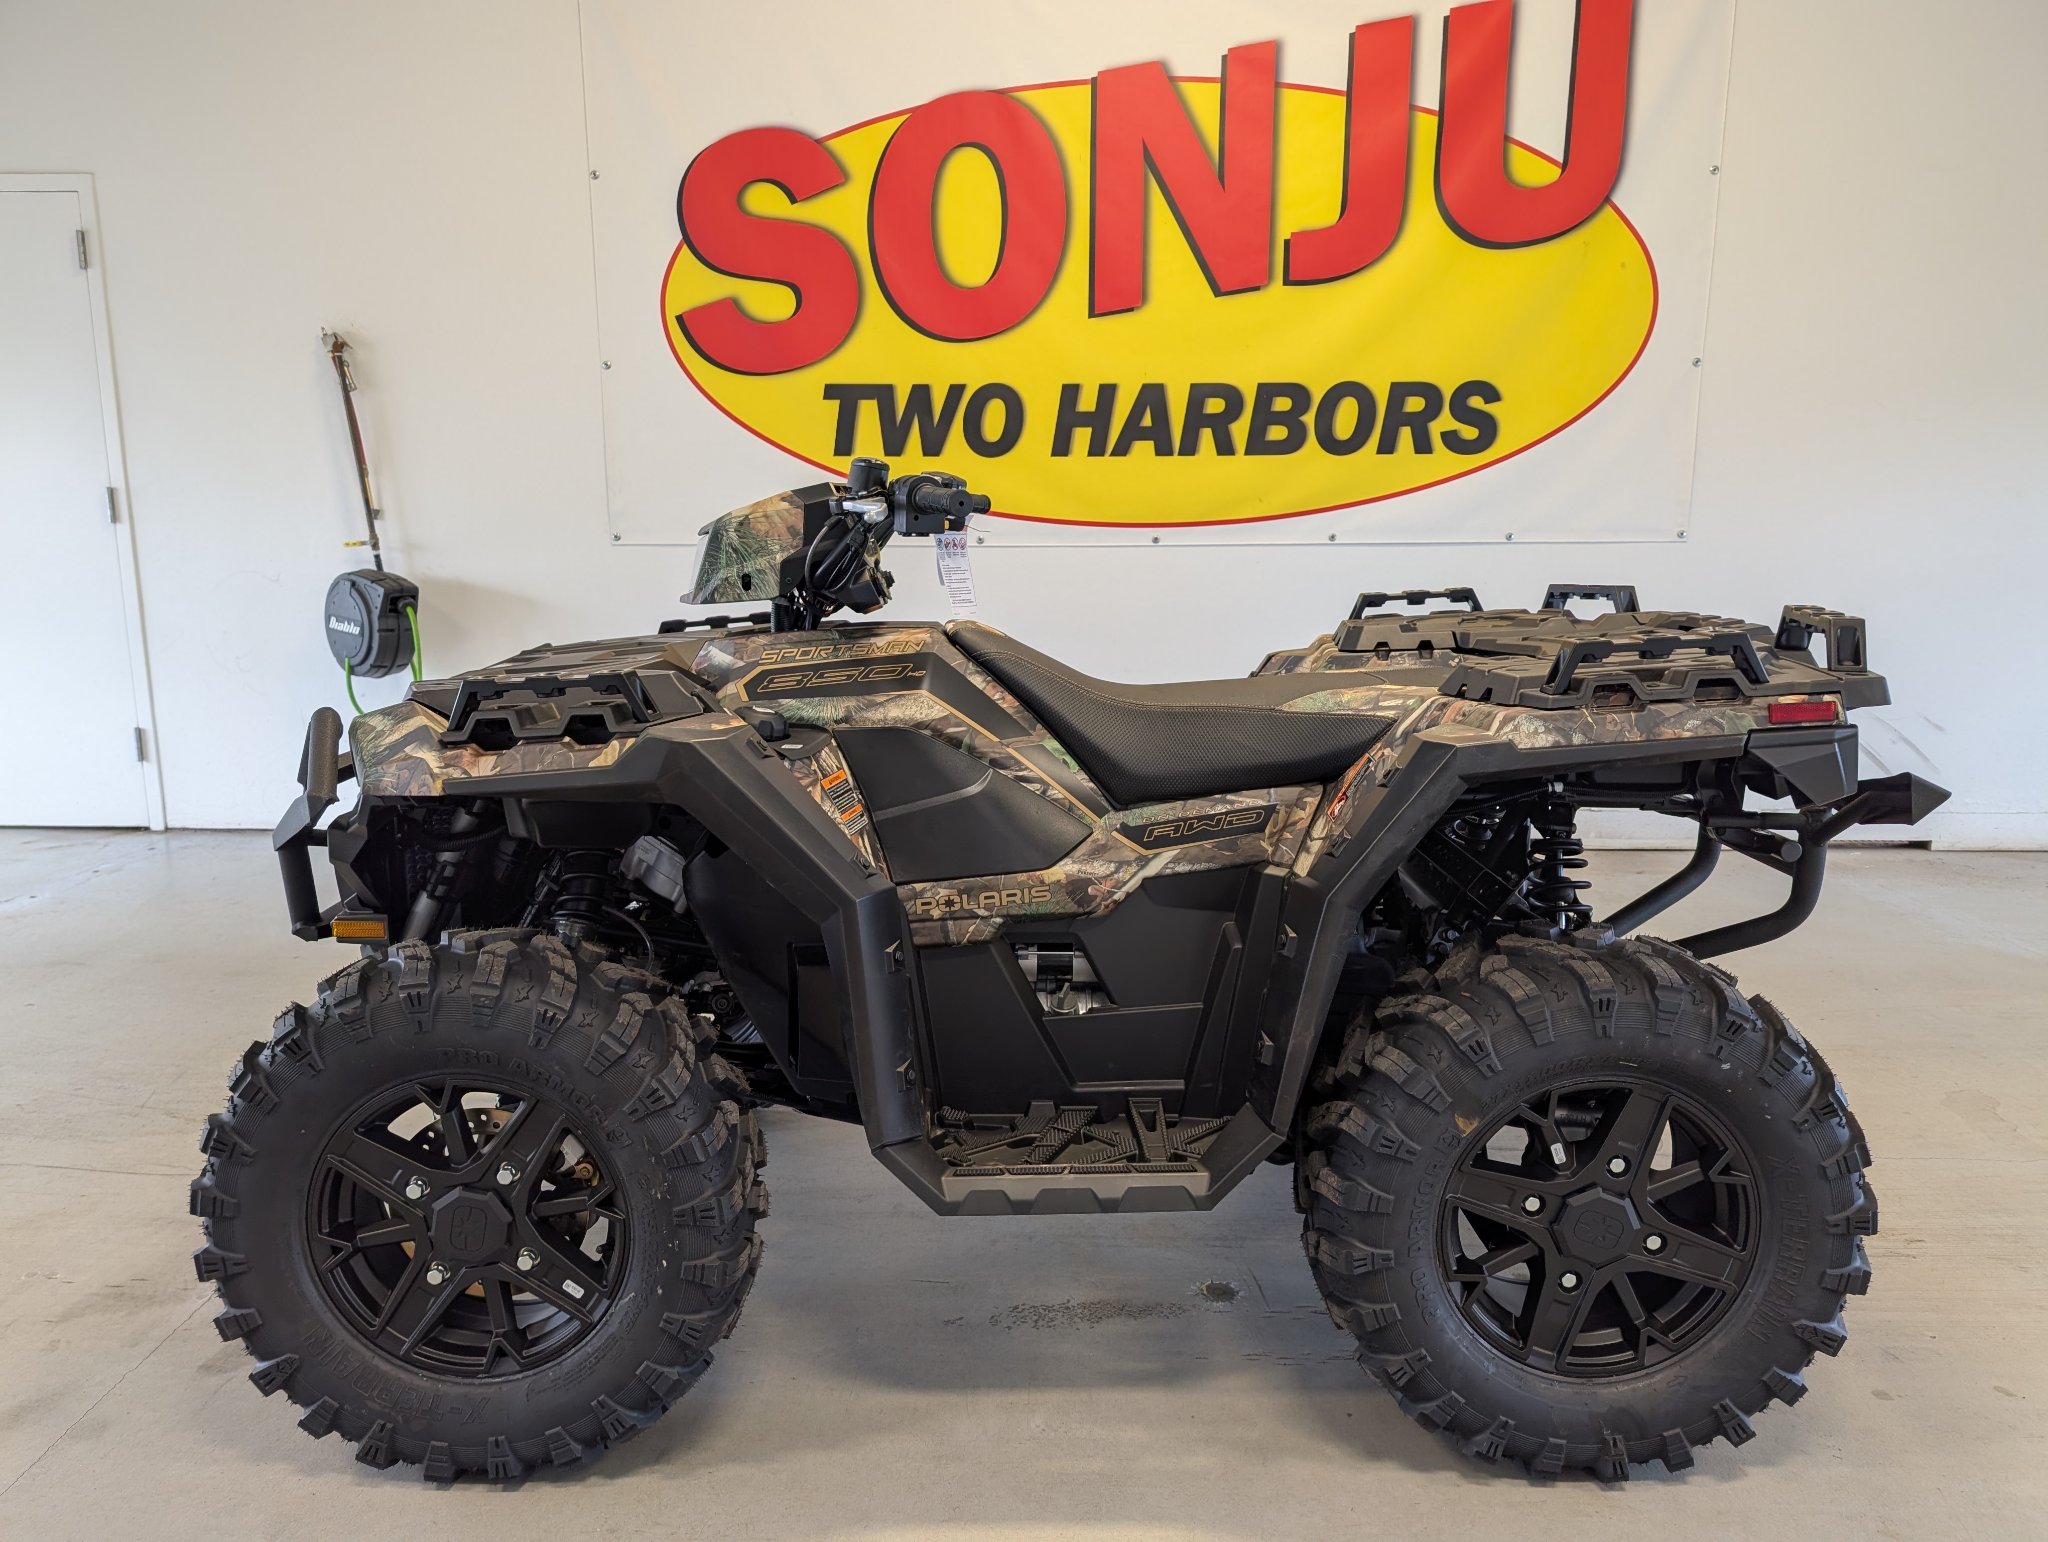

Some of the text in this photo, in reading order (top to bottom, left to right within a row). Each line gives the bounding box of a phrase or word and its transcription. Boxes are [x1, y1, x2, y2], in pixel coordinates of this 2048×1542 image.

[677, 0, 1634, 376] SONJU
[822, 379, 1502, 459] TWO HARBORS
[328, 615, 361, 636] Diablo
[758, 640, 927, 664] SPORTSMAN
[757, 663, 914, 693] 850
[1179, 800, 1264, 818] DEMAND
[1143, 809, 1265, 842] AWD
[914, 886, 1052, 916] POLARIS
